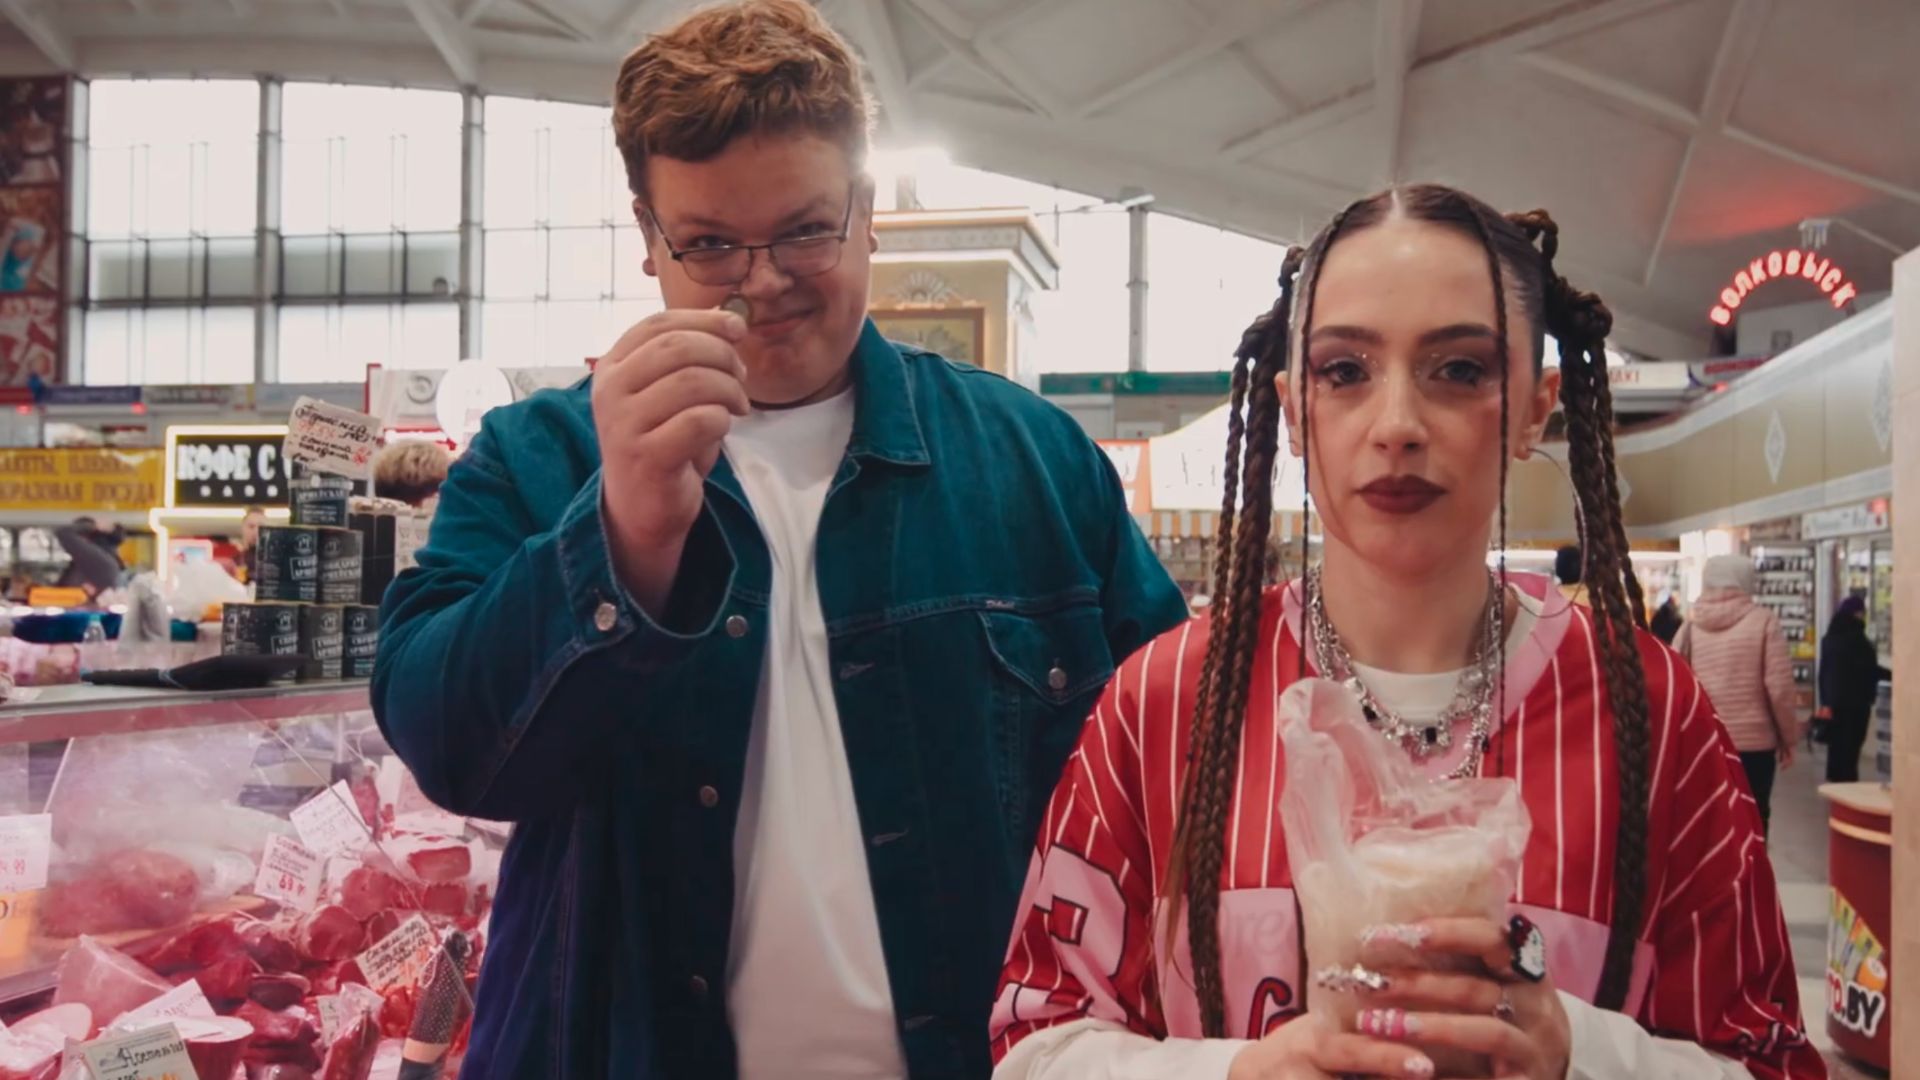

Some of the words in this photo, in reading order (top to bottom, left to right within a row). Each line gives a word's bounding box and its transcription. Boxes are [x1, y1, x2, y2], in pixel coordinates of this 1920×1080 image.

[1709, 249, 1856, 326] ВОЛКОВЫСК
[177, 444, 251, 480] КОФЕ
[258, 444, 276, 480] С
